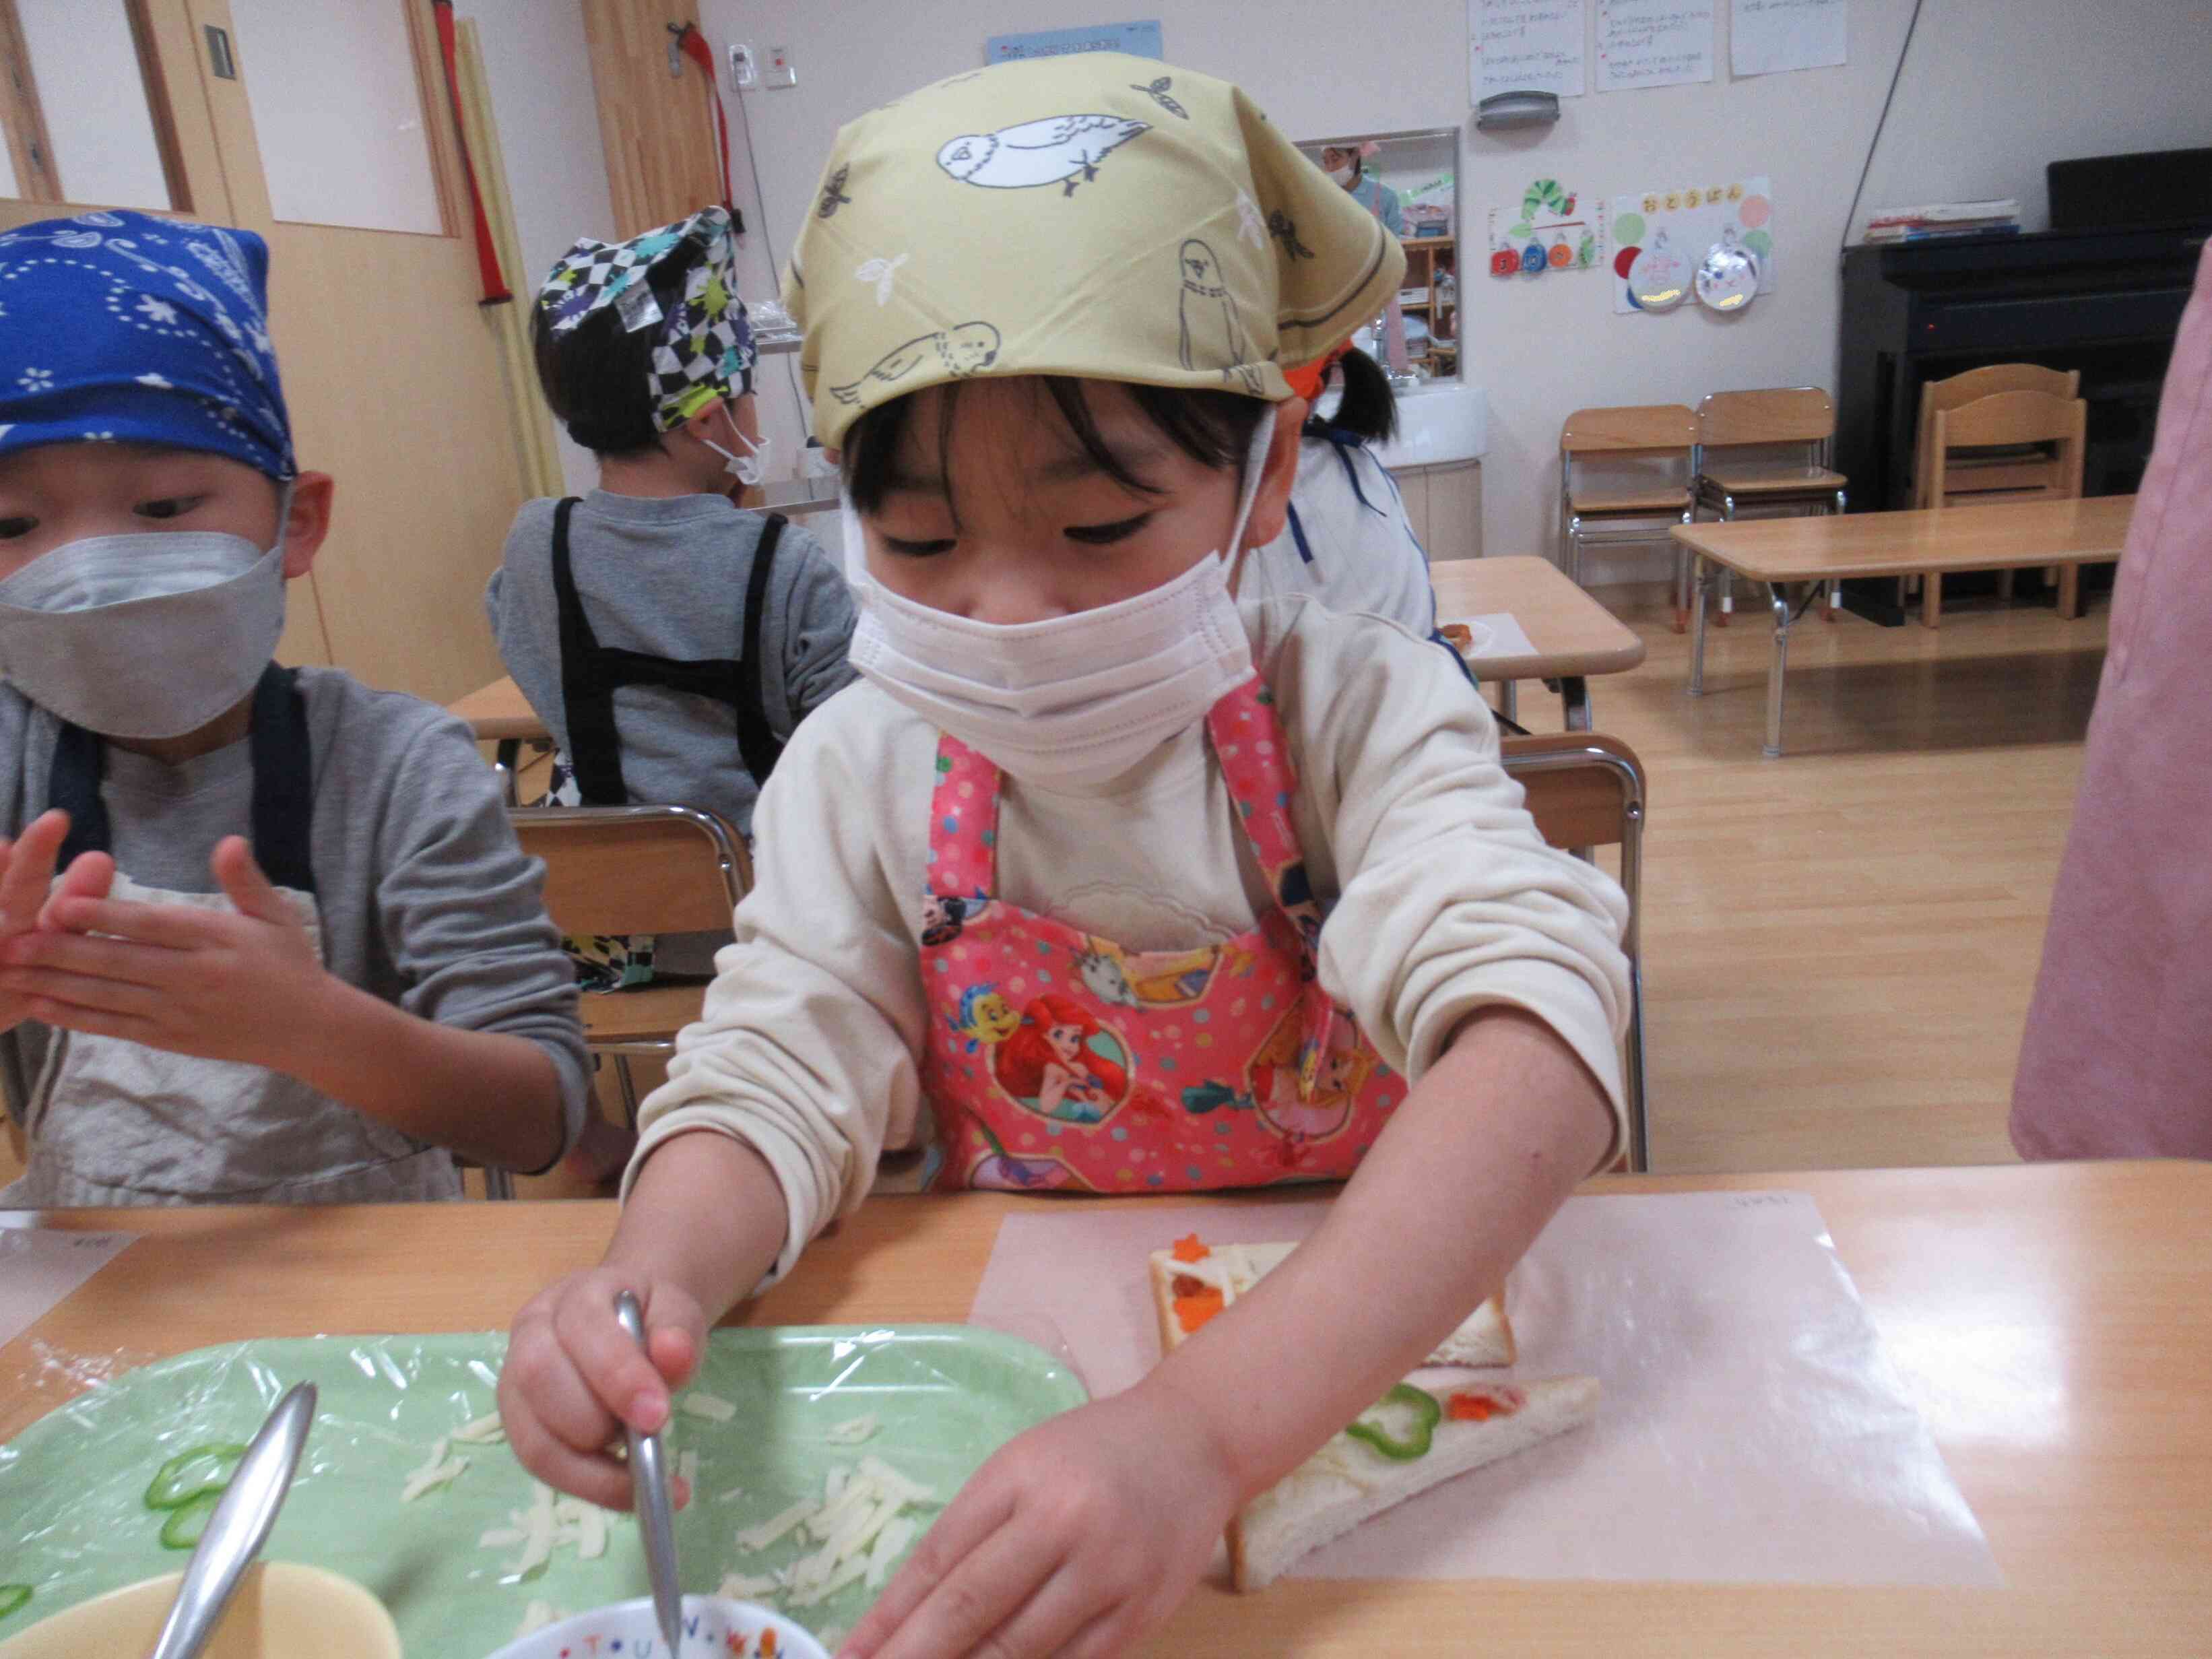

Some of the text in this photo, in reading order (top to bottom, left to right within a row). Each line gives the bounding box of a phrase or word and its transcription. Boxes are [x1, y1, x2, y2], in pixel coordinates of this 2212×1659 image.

[1642, 184, 1742, 214] おとうばん
